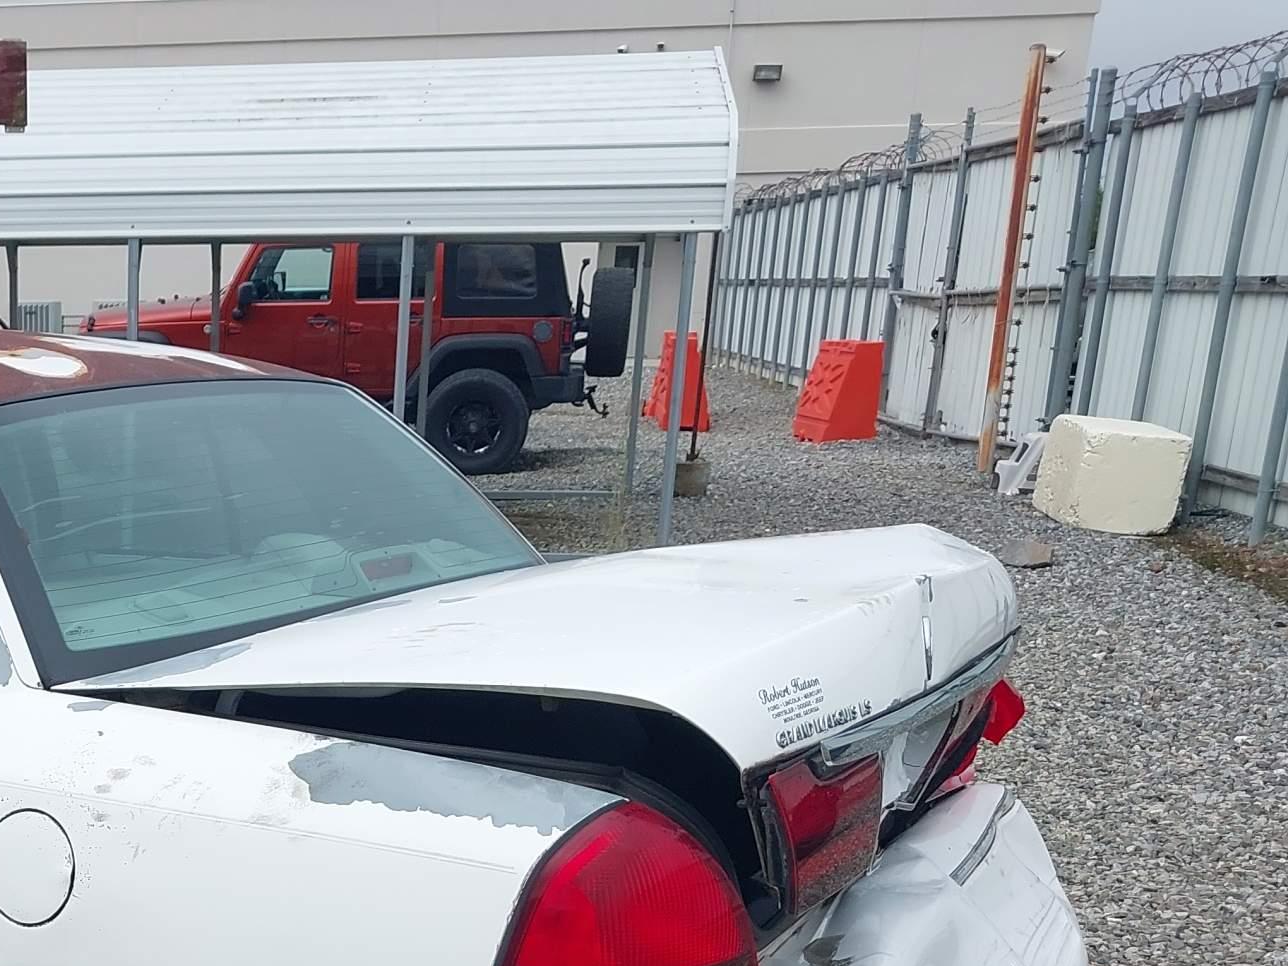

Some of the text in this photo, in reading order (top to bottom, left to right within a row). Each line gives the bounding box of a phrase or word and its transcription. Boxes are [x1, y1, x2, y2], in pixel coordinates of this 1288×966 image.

[758, 685, 791, 705] Robert
[767, 688, 823, 712] FORD LINCOLN MERCURY
[772, 707, 794, 719] CHRYSLER
[796, 700, 812, 711] DODGE
[858, 699, 873, 719] LS
